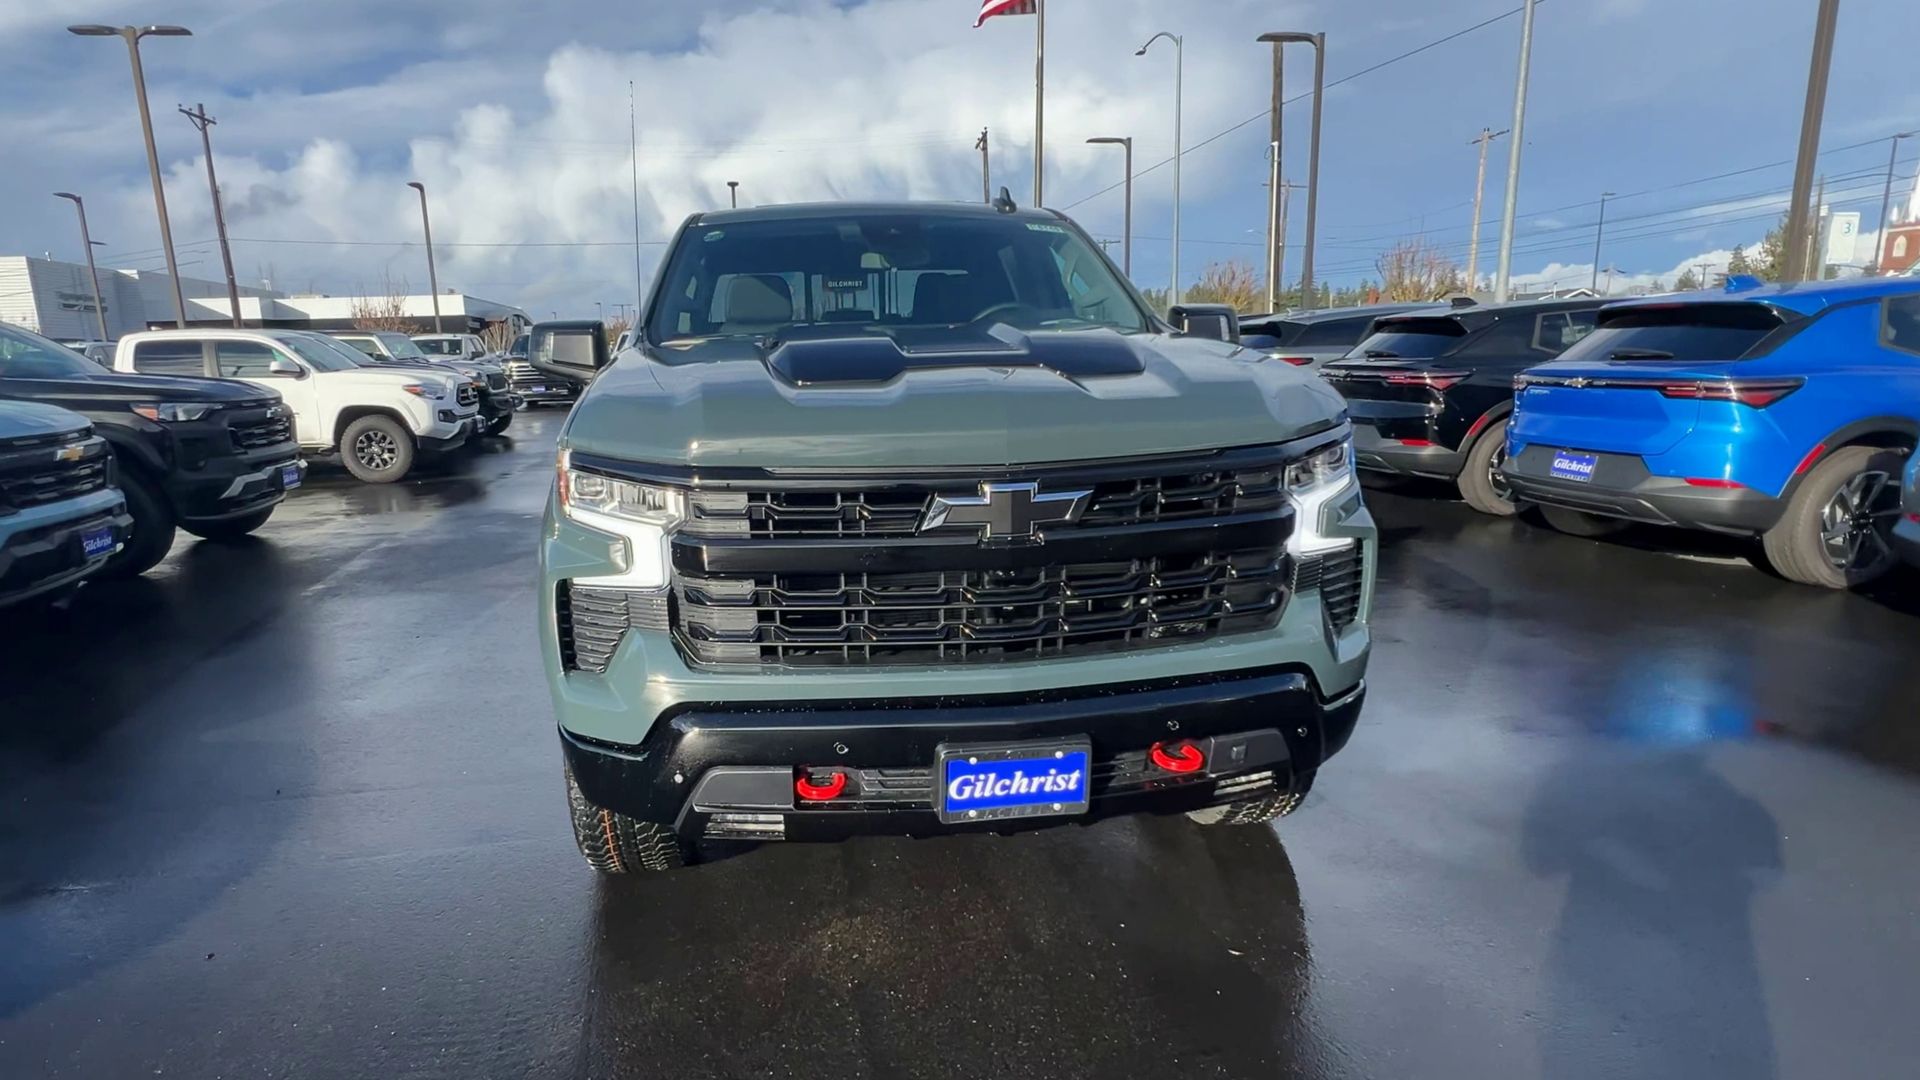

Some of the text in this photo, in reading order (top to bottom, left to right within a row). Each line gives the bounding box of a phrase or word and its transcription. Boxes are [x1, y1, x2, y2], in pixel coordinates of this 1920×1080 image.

[1844, 222, 1851, 234] 3
[827, 280, 863, 288] GILCHRIST
[1554, 458, 1593, 473] Gilchrist
[948, 768, 1081, 800] Gilchrist
